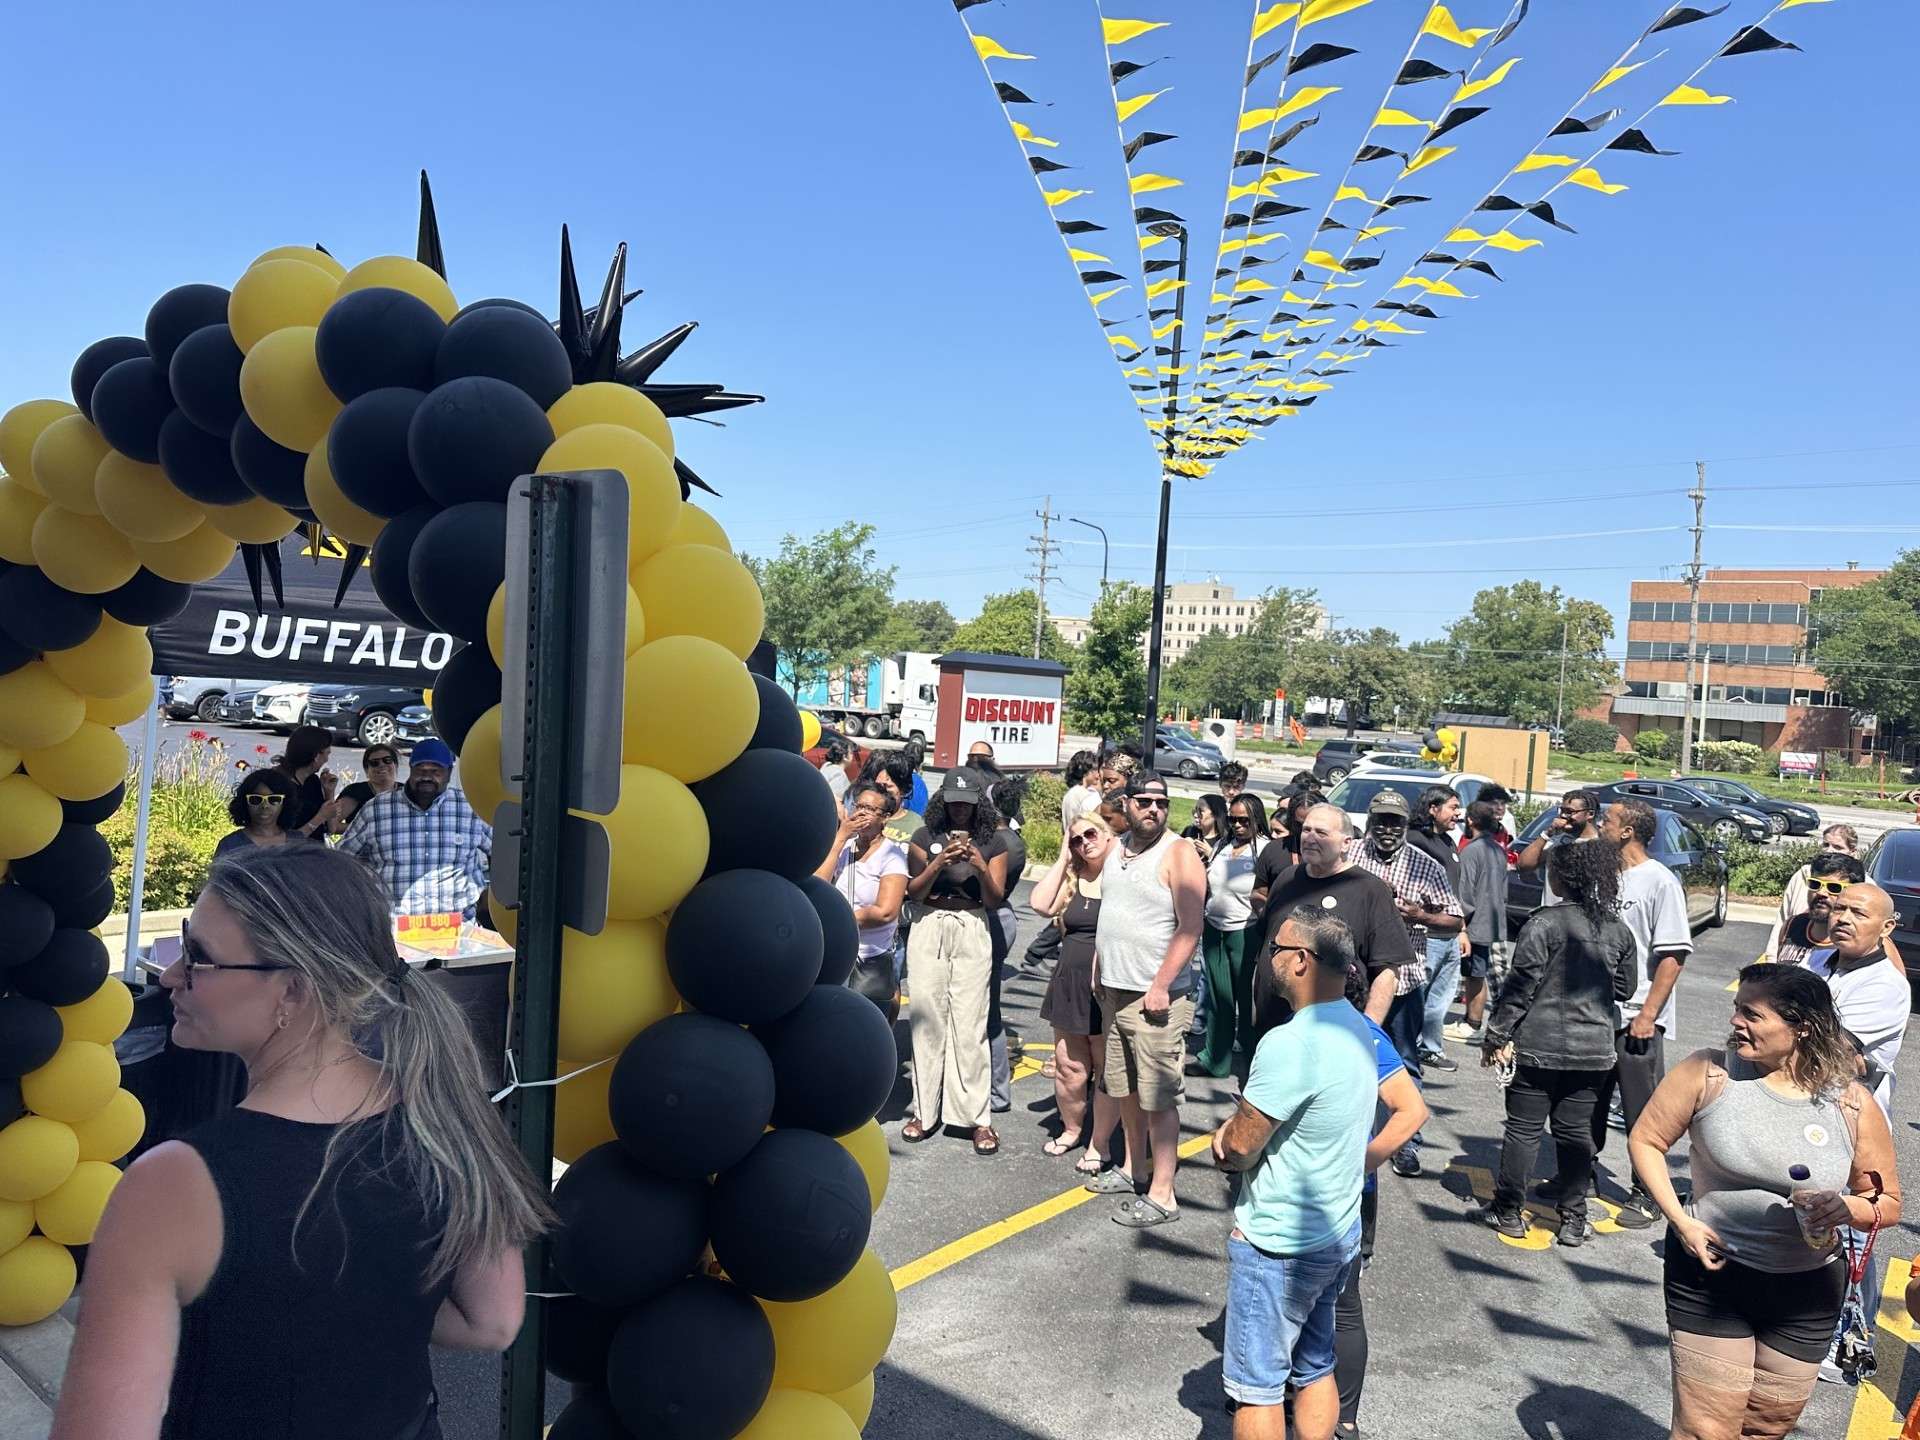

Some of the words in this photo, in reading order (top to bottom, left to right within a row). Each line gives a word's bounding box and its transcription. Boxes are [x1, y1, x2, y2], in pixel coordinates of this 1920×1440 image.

[208, 609, 453, 671] BUFFALO
[965, 697, 1055, 725] DISCOUNT
[991, 726, 1029, 742] TIRE
